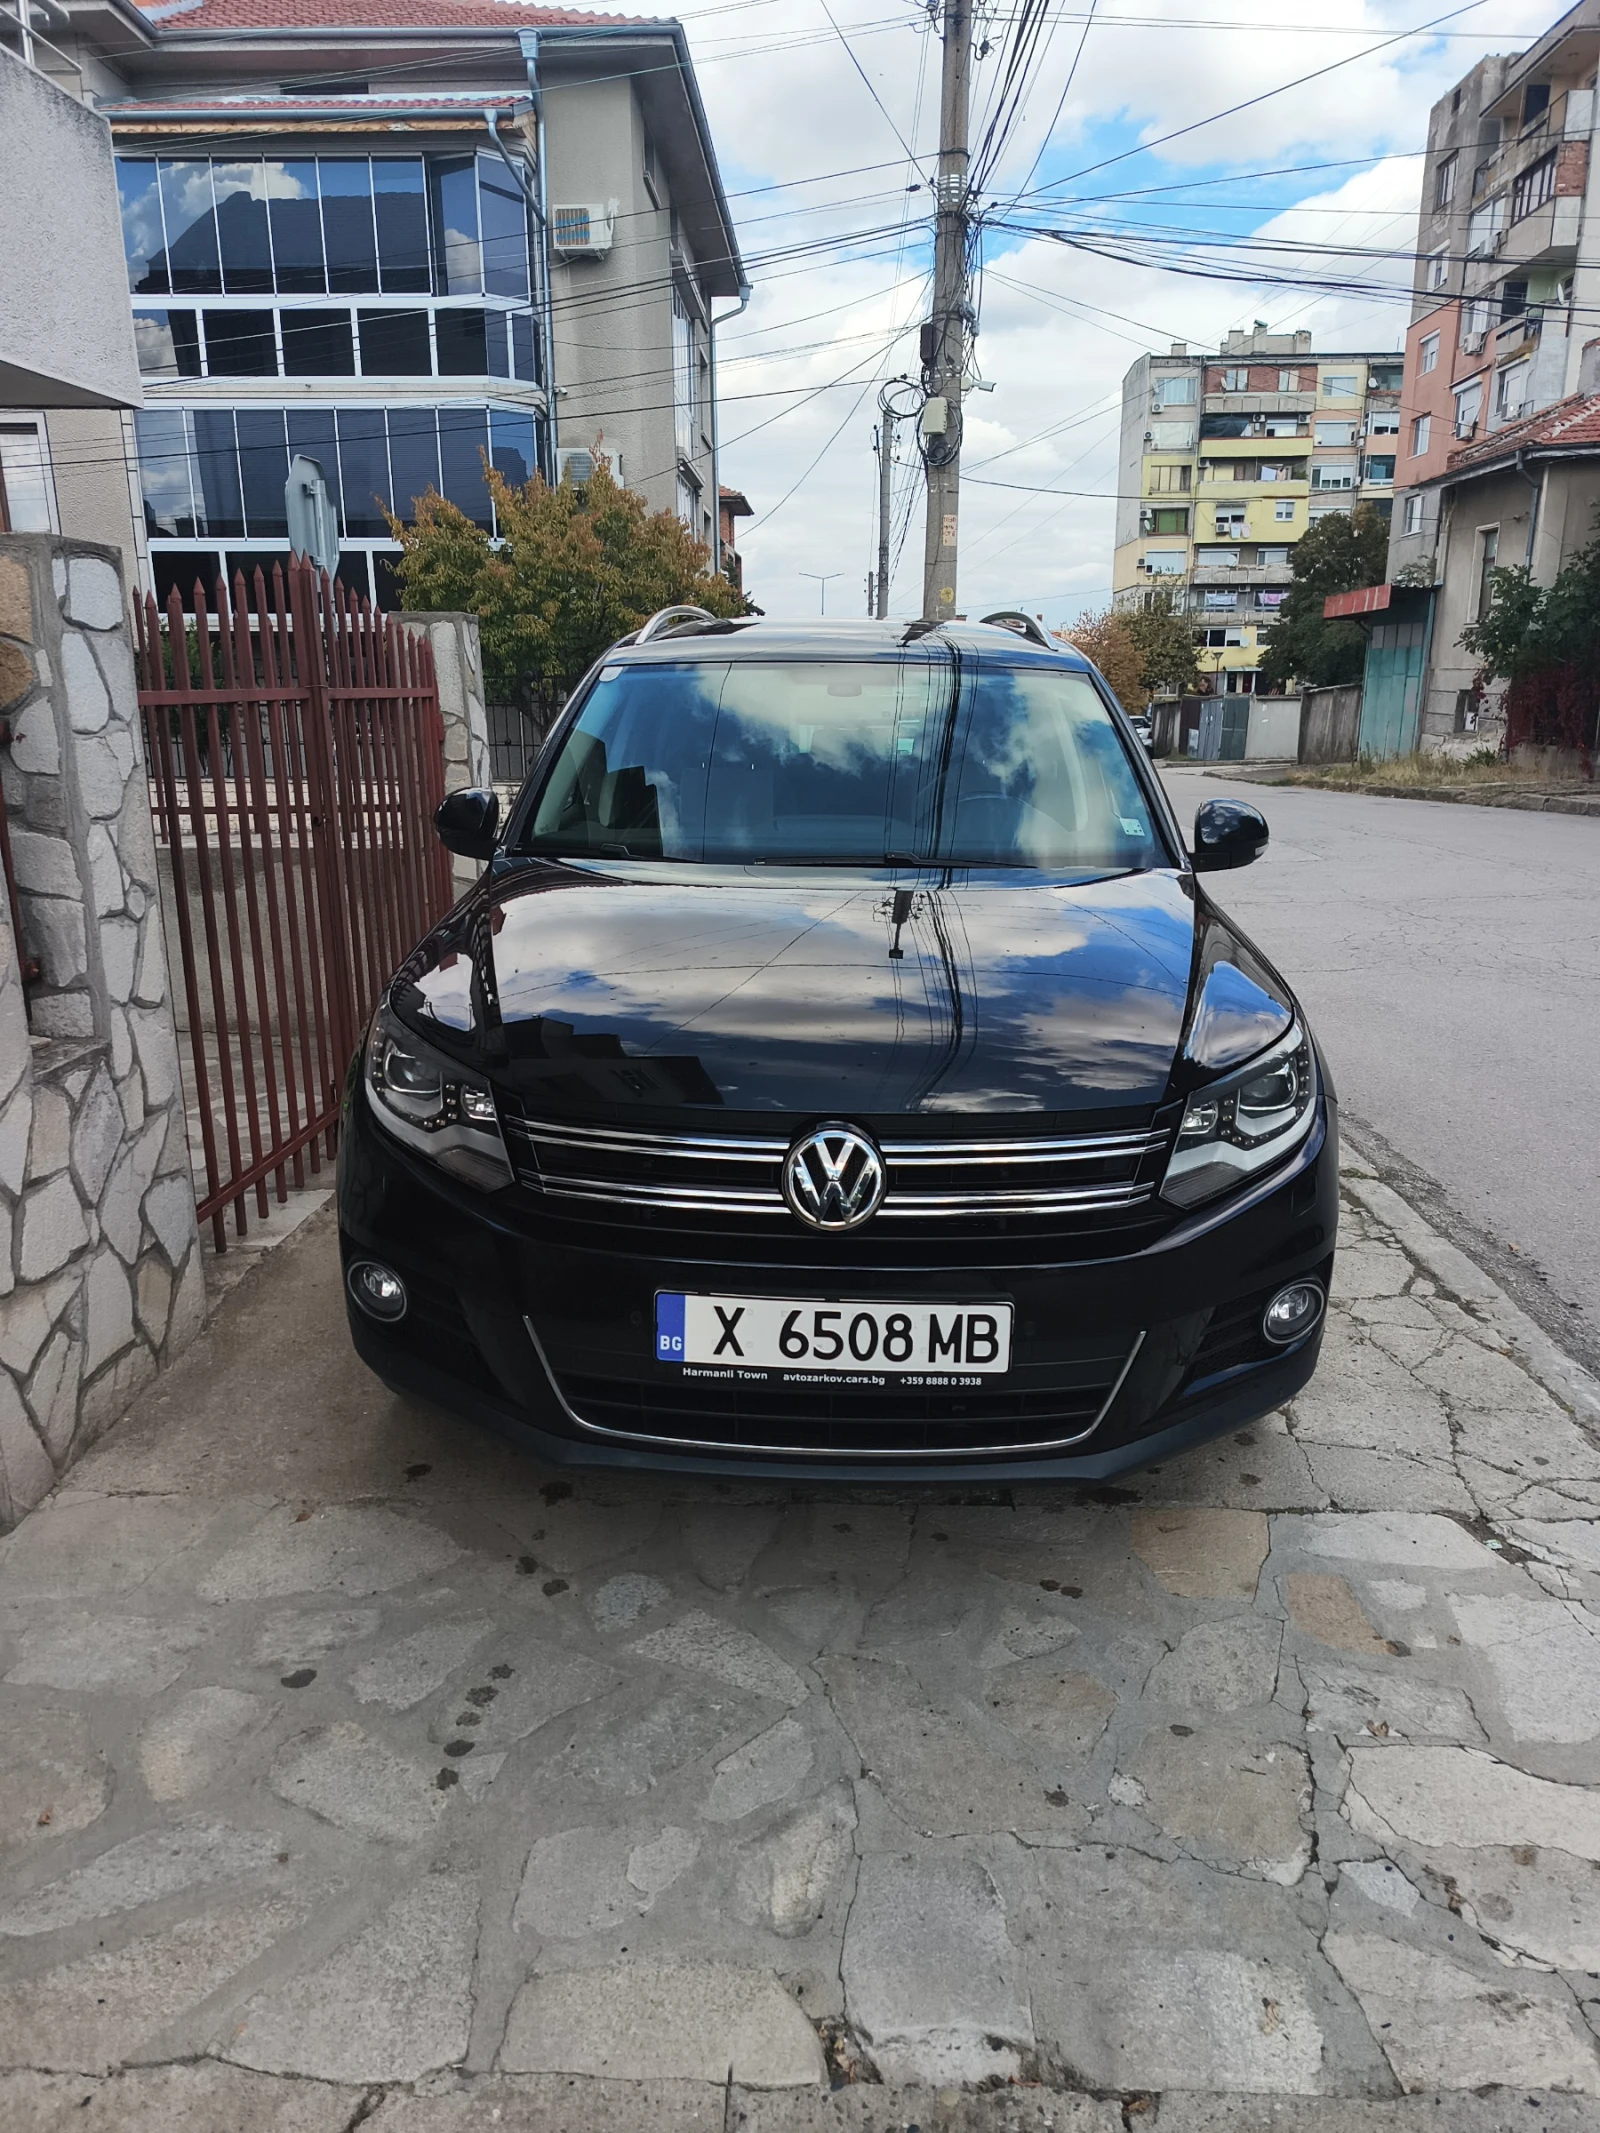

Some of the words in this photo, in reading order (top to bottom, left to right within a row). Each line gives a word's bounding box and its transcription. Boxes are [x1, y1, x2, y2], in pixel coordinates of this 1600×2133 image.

[713, 1305, 746, 1357] X
[779, 1310, 914, 1362] 6508
[928, 1313, 999, 1363] MB
[660, 1335, 682, 1351] BG
[682, 1367, 734, 1378] Harmanli
[737, 1370, 768, 1380] Town
[783, 1373, 885, 1386] avtozarkov.cars.bg
[900, 1376, 924, 1385] +359
[959, 1377, 982, 1386] 3938
